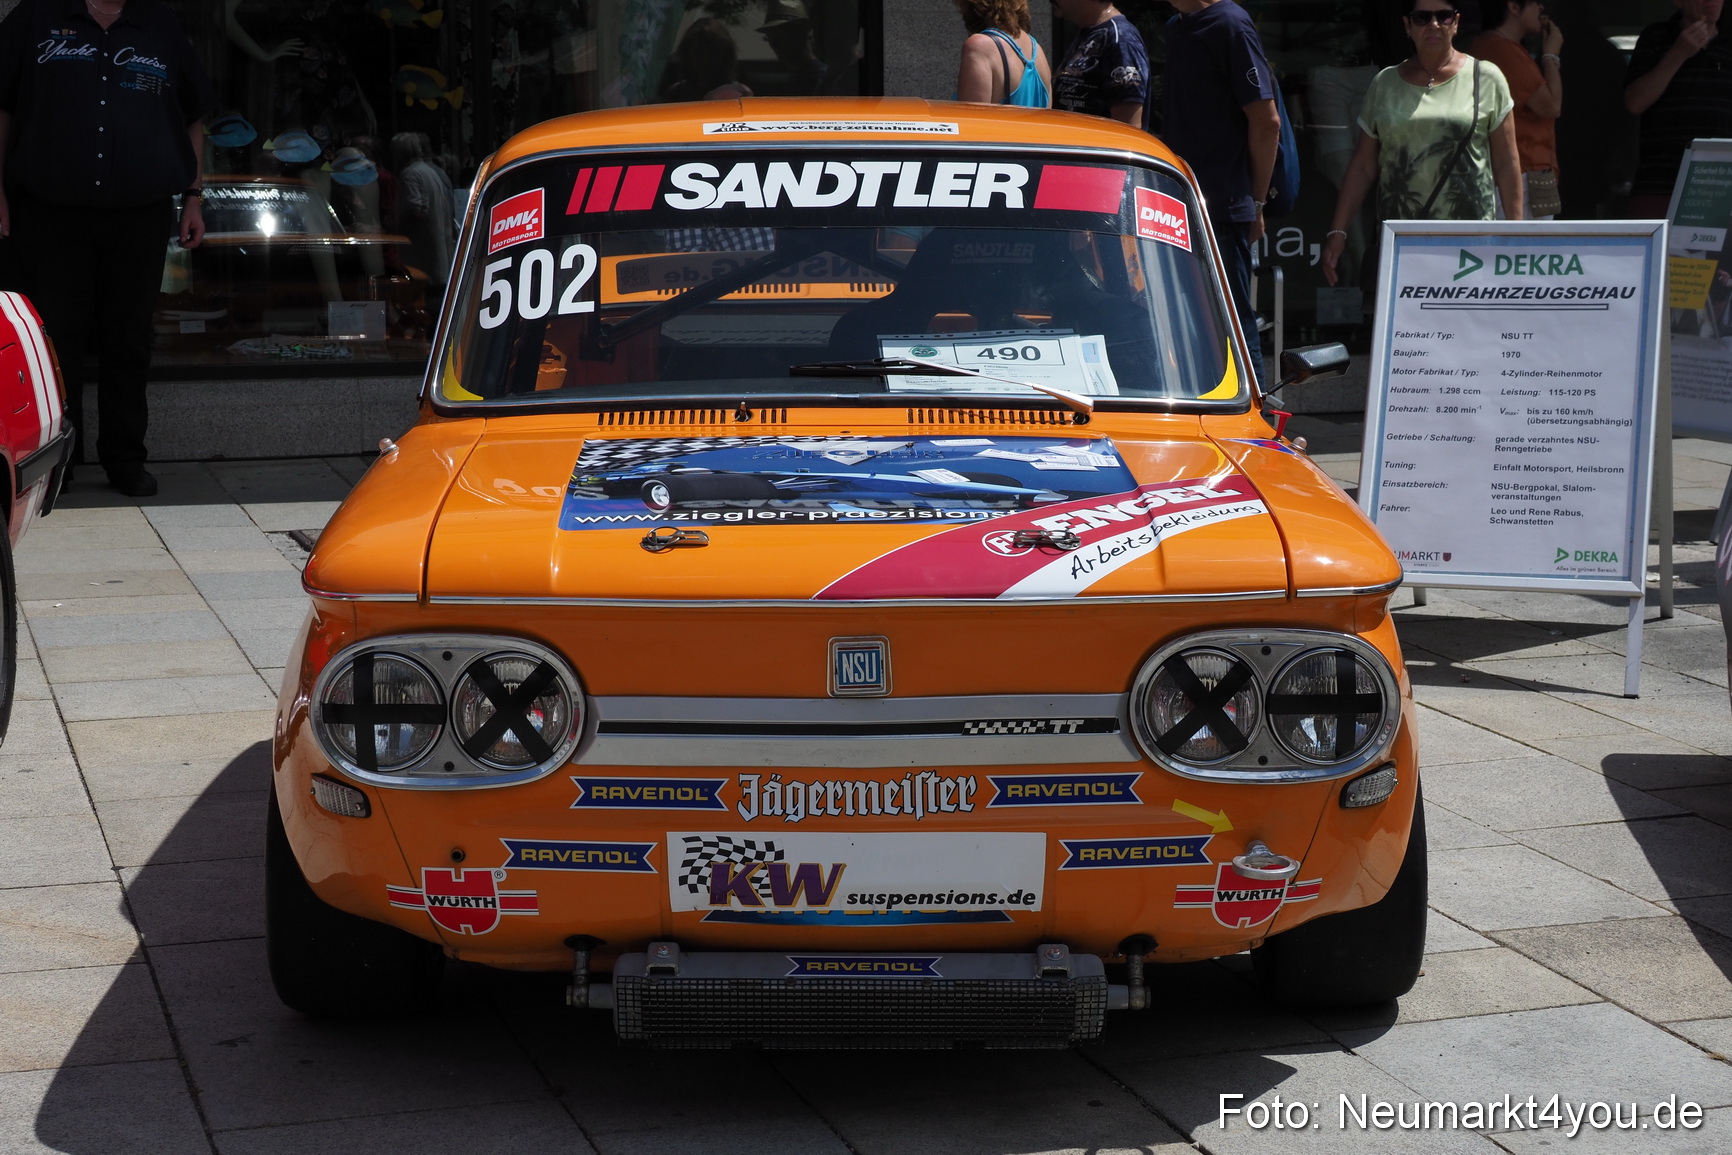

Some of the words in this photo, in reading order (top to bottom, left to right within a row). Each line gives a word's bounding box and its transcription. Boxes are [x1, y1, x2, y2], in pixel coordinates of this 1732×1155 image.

[38, 39, 98, 64] Yacht
[113, 47, 167, 71] Cruise
[760, 124, 954, 133] www.berg-zeitnahme.net
[664, 161, 1029, 210] SANDTLER
[493, 208, 538, 236] DMV
[1140, 207, 1184, 229] DMV
[492, 231, 538, 250] MOTORSPORT
[1142, 228, 1187, 246] MOTORSPORT
[1698, 235, 1716, 243] DEKRA
[952, 242, 1035, 258] SANDTLER
[1494, 254, 1584, 276] DEKRA
[479, 244, 598, 330] 502
[1399, 286, 1637, 300] RENNFAHRZEUGSCHAU
[1394, 331, 1429, 340] Fabrikat
[1436, 332, 1455, 341] Typ:
[1501, 332, 1520, 340] NSU
[1522, 332, 1534, 340] TT
[977, 345, 1041, 361] 490
[1393, 350, 1429, 358] Baujahr:
[1501, 351, 1521, 359] 1970
[1392, 368, 1416, 376] Motor
[1418, 368, 1454, 376] Fabrikat
[1461, 369, 1479, 378] Typ:
[1500, 370, 1602, 379] 4-Zylinder-Reihenmotor
[1390, 386, 1431, 394] Hubraum:
[1438, 387, 1460, 395] 1.298
[1500, 388, 1541, 397] Leistung:
[1388, 405, 1429, 414] Drehzahl:
[1436, 406, 1458, 414] 8.200
[1527, 408, 1540, 416] bis
[1555, 408, 1570, 416] 160
[1572, 408, 1594, 416] km/h
[1527, 417, 1633, 427] (übersetzungsabhängig)
[1386, 434, 1422, 442] Getriebe
[1430, 434, 1475, 444] Schaltung:
[1495, 436, 1525, 445] gerade
[1527, 436, 1574, 444] verzahntes
[1494, 445, 1552, 454] Renngetriebe
[1384, 461, 1416, 470] Tuning:
[1493, 464, 1521, 472] Einfalt
[1523, 465, 1574, 474] Motorsport,
[1576, 465, 1624, 473] Heilsbronn
[1382, 480, 1448, 489] Einsatzbereich:
[1491, 483, 1560, 493] NSU-Bergpokal,
[1562, 484, 1596, 492] Slalom-
[1491, 493, 1561, 502] veranstaltungen
[1030, 485, 1242, 536] ENGEL
[1380, 504, 1411, 512] Fahrer:
[1491, 508, 1507, 516] Leo
[1509, 508, 1526, 516] und
[1554, 509, 1584, 517] Rabus,
[1490, 518, 1554, 526] Schwanstetten
[1070, 503, 1262, 580] Arbeitsbekleidung
[1574, 550, 1618, 563] DEKRA
[842, 652, 878, 684] NSU
[1048, 720, 1084, 734] TT
[592, 786, 704, 802] RAVENOL
[1007, 782, 1122, 798] RAVENOL
[521, 848, 637, 864] RAVENOL
[1079, 845, 1194, 861] RAVENOL
[708, 862, 848, 908] KW
[846, 890, 1036, 910] suspensions.de
[1217, 888, 1284, 902] WÜRTH
[427, 894, 497, 909] WÜRTH
[806, 962, 921, 972] RAVENOL
